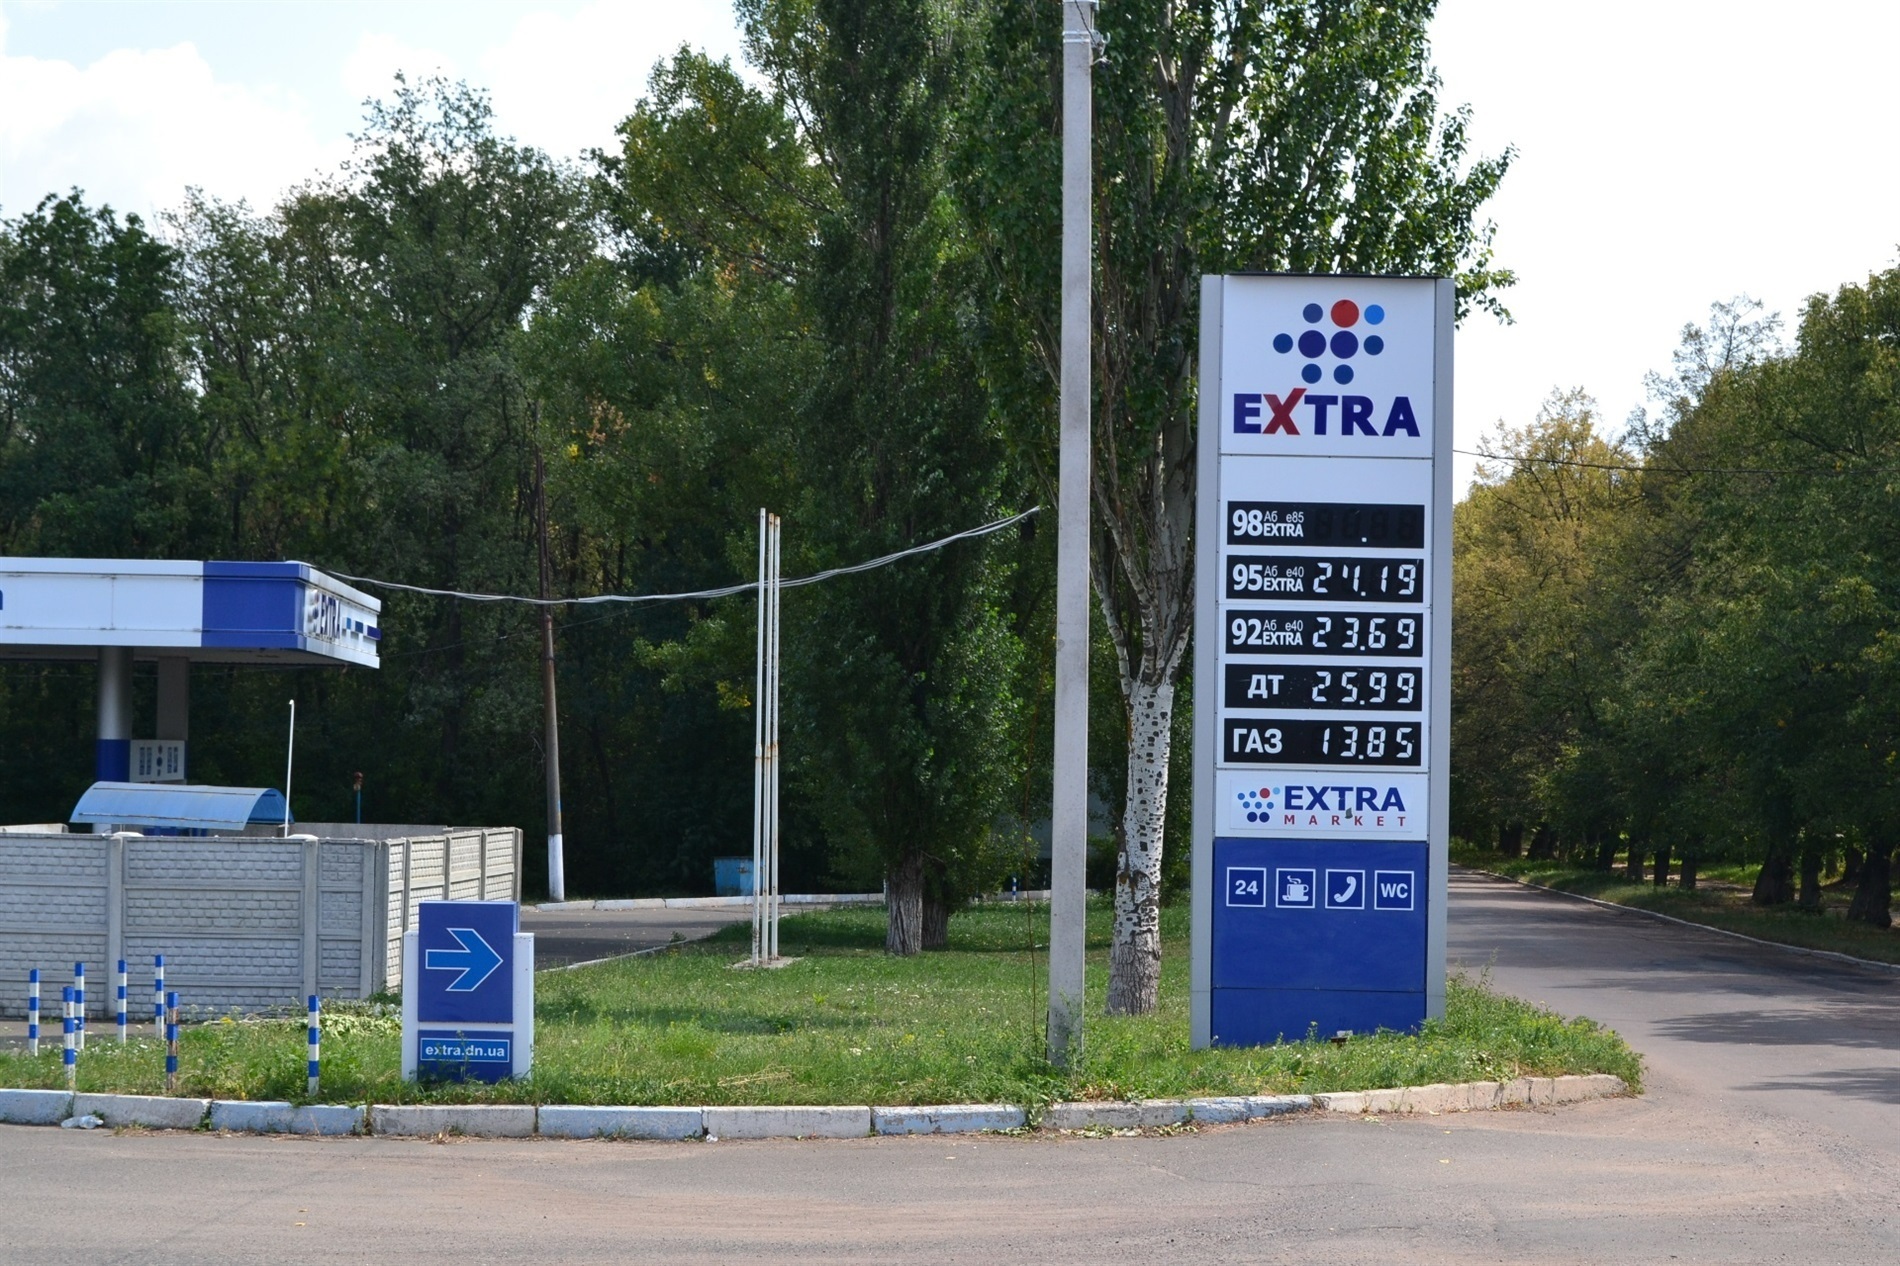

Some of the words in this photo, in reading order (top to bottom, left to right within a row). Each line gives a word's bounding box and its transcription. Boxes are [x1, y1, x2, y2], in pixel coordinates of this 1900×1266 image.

[1233, 388, 1420, 437] EXTRA
[1232, 509, 1263, 537] 98
[1286, 511, 1304, 523] e85
[1263, 523, 1304, 537] EXTRA
[1232, 563, 1263, 591] 95
[1286, 566, 1304, 578] e40
[1313, 562, 1416, 596] 24.19
[1263, 578, 1304, 592] EXTRA
[1231, 618, 1262, 645] 92
[1285, 620, 1303, 632] e40
[1312, 617, 1415, 651] 23.69
[1262, 632, 1303, 646] EXTRA
[1247, 674, 1284, 699] ДТ
[1312, 671, 1415, 705] 25.99
[1233, 728, 1283, 754] ГАЗ
[1322, 726, 1413, 760] 13.85
[1284, 785, 1406, 812] EXTRA
[1284, 814, 1406, 827] MARKET
[1235, 880, 1258, 895] 24
[1380, 883, 1409, 899] WC
[425, 1044, 505, 1057] extra.dn.ua
